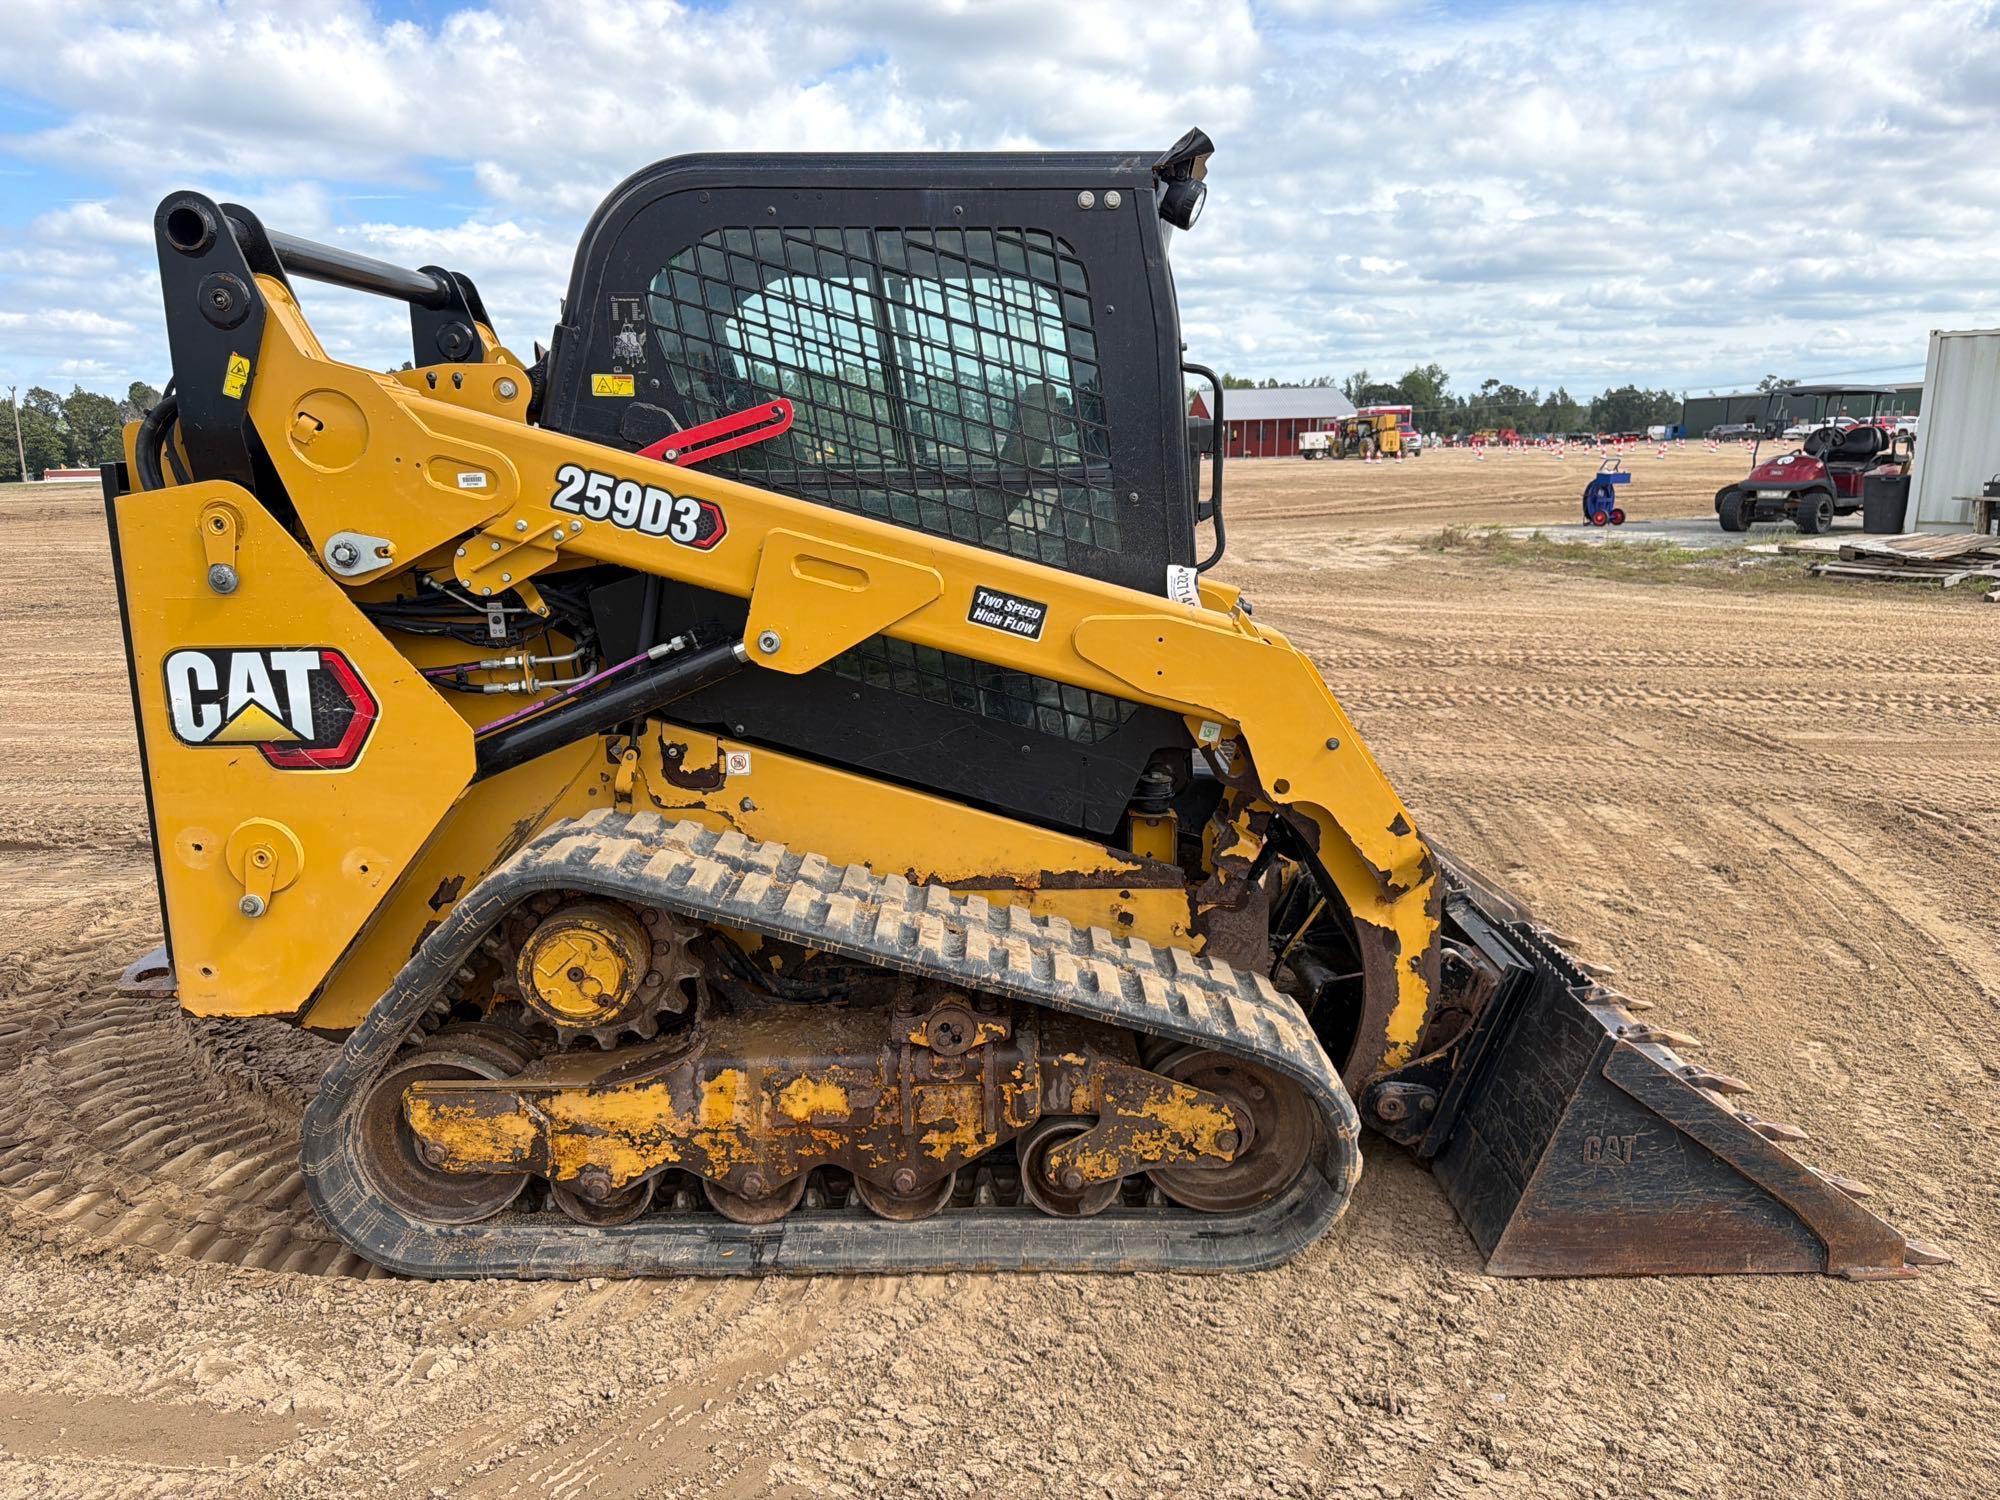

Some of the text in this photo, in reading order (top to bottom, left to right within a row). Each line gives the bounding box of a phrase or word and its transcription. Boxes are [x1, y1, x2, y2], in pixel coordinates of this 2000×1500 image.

[553, 465, 701, 542] 259D3
[167, 651, 320, 742] CAT
[1583, 1135, 1637, 1167] CAT
